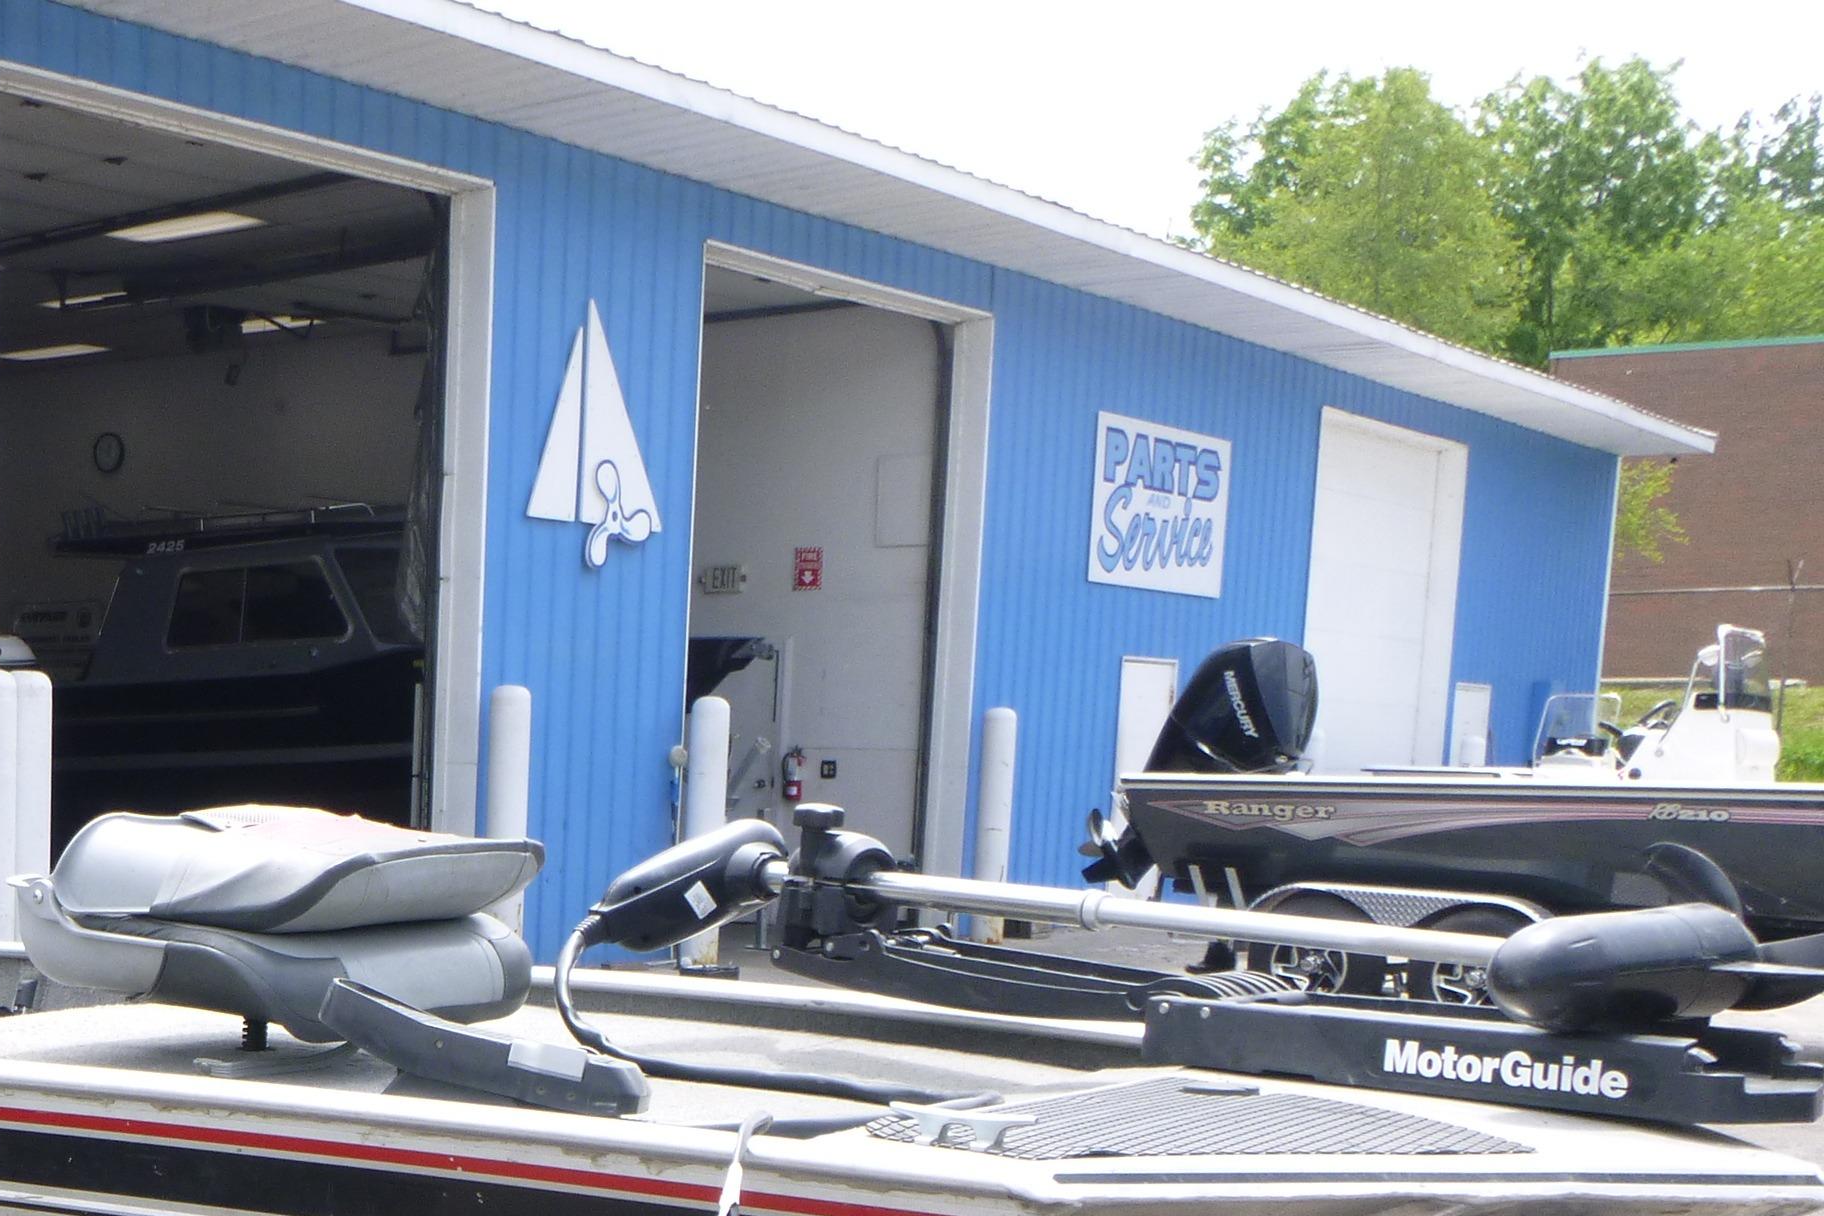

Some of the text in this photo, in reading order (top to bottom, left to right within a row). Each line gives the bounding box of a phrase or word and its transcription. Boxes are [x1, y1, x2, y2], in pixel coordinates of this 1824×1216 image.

[1103, 426, 1222, 502] PARTS
[1145, 494, 1172, 509] AND
[146, 539, 185, 555] 2425
[1097, 483, 1213, 573] Service
[712, 567, 737, 589] EXIT
[1223, 670, 1259, 738] MERCURY
[1203, 800, 1335, 821] Ranger
[1383, 1038, 1629, 1099] MotorGuide
